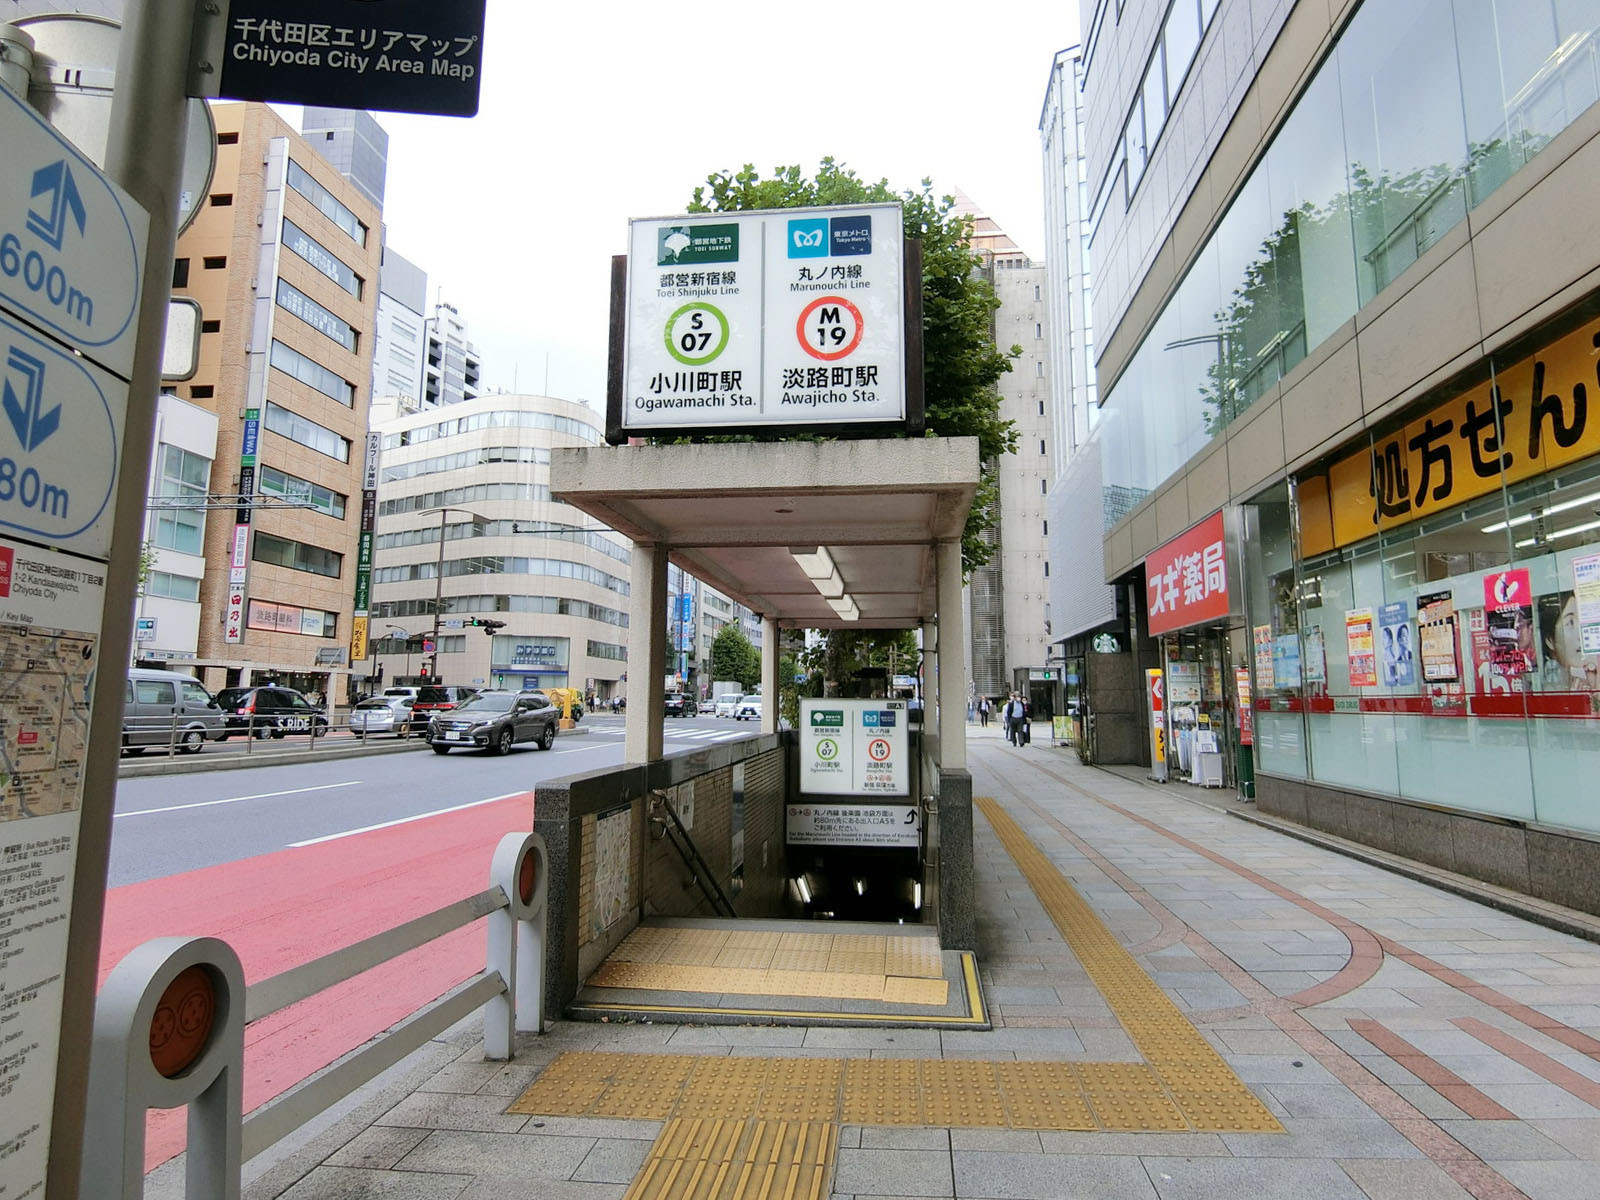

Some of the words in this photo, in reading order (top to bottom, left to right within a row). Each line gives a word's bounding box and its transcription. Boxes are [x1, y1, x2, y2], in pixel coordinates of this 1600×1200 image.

[234, 18, 478, 57] 千代田区エリアマップ
[232, 43, 320, 66] Chiyoda
[327, 50, 369, 73] City
[375, 55, 424, 74] Area
[431, 58, 474, 81] Map
[834, 229, 868, 237] 東京メトロ
[0, 233, 94, 327] 600m
[660, 271, 736, 287] 都営新宿線
[799, 264, 862, 280] 丸ノ内線
[656, 288, 675, 298] Toei
[678, 287, 717, 298] Shinjuku
[720, 286, 739, 295] Line
[790, 280, 847, 292] Marunouchi
[850, 279, 870, 289] Line
[691, 313, 703, 329] S
[820, 307, 840, 324] M
[681, 333, 711, 352] 07
[817, 327, 846, 346] 19
[650, 371, 742, 394] 小川町駅
[782, 366, 878, 390] 淡路町駅
[635, 394, 725, 412] Ogawamachi
[730, 393, 756, 407] Sta.
[781, 391, 847, 407] Awajicho
[852, 390, 879, 402] Sta.
[1370, 330, 1600, 525] 処方せん
[0, 457, 69, 519] 80m
[15, 572, 26, 583] 1-2
[1149, 541, 1226, 616] スギ薬局
[12, 583, 42, 597] Chiyoda
[44, 589, 57, 601] City
[1495, 603, 1520, 613] CLEVER
